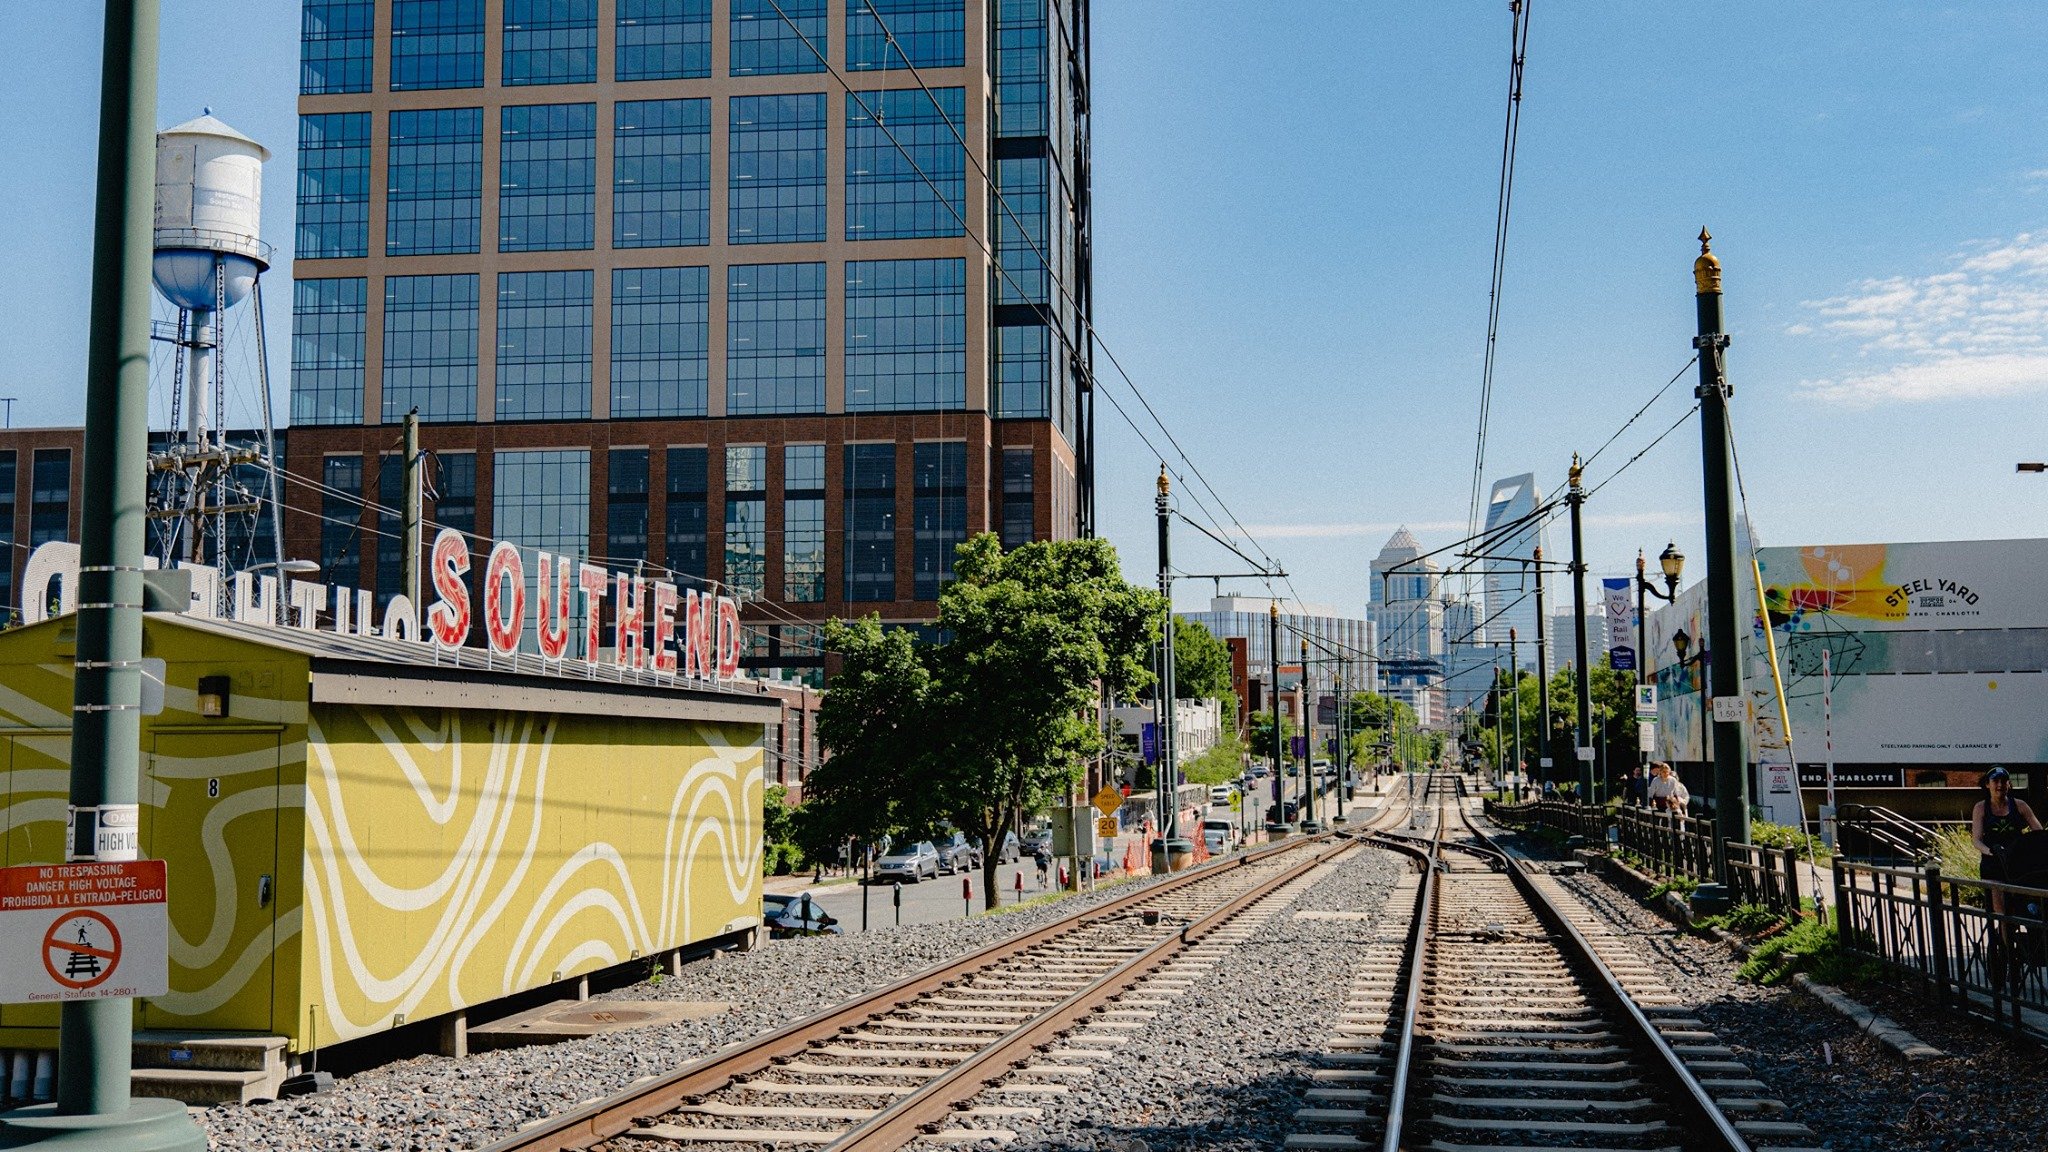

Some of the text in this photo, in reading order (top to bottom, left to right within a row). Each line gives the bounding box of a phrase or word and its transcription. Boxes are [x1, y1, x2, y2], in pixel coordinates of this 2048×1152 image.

[1885, 578, 1979, 607] STEEL YARD
[209, 778, 218, 797] 8
[1101, 820, 1116, 830] 20
[99, 833, 123, 850] HIGH
[40, 864, 123, 878] NO TRESPASSING
[27, 876, 137, 892] DANGER HIGH VOLTAGE
[3, 888, 162, 907] PROHIBIDA LA ENTRADA-PELIGRO
[28, 987, 137, 1001] General Statute 14-280.1
